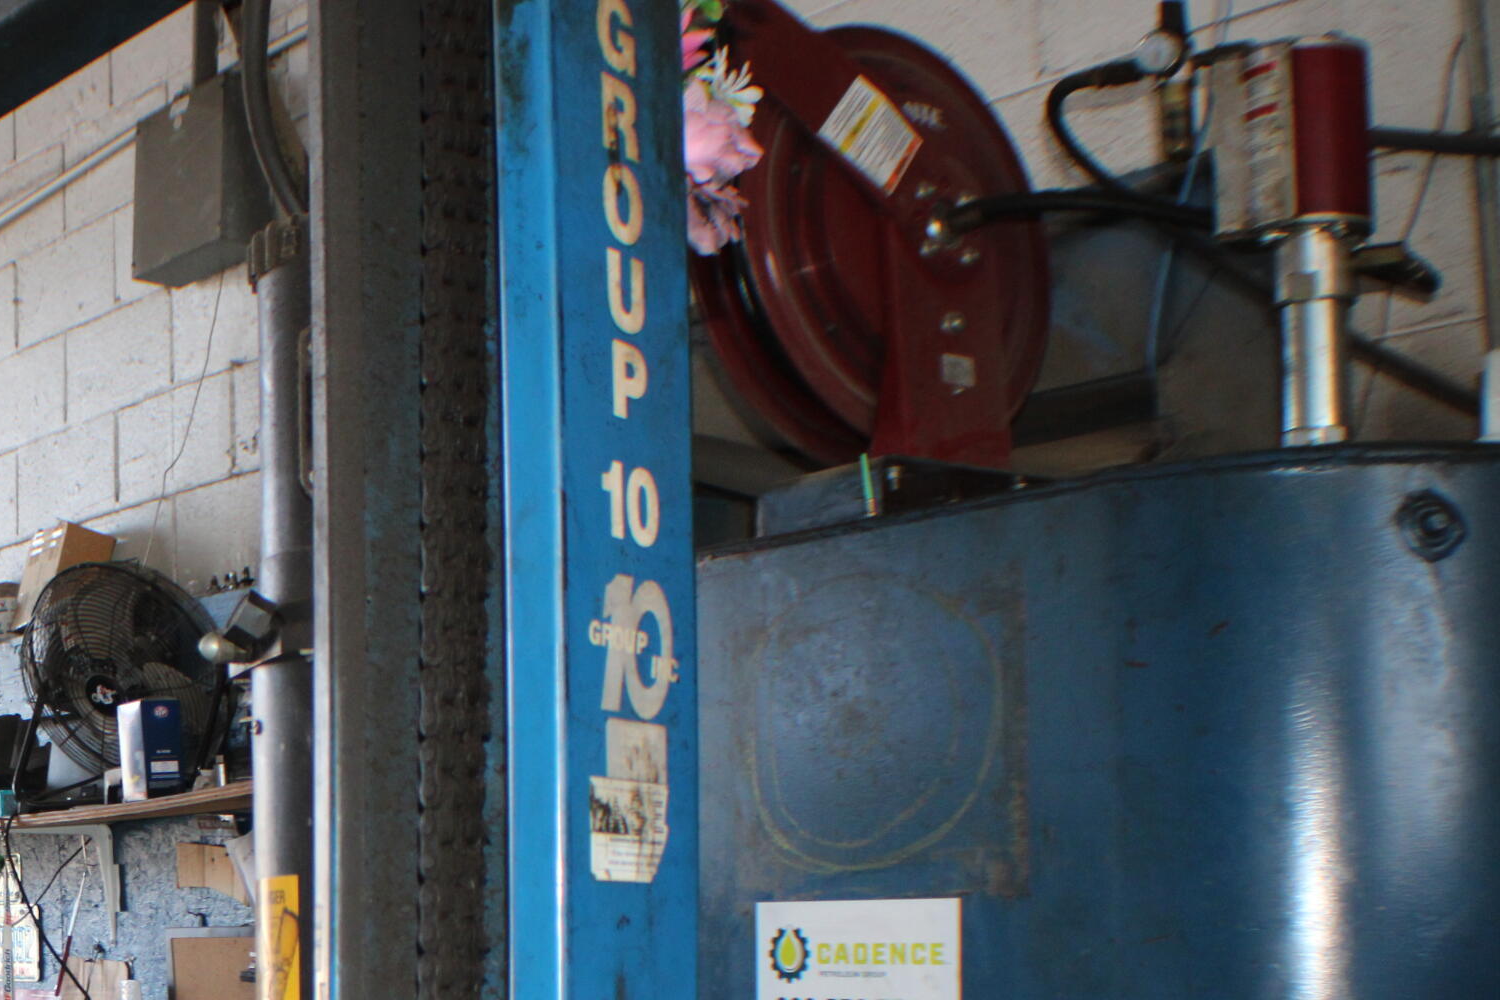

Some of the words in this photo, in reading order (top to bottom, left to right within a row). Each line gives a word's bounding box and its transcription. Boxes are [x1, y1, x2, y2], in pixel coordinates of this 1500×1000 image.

[596, 0, 648, 420] GROUP
[601, 460, 661, 548] 10
[588, 619, 649, 655] GROUP
[816, 942, 946, 966] CADENCE
